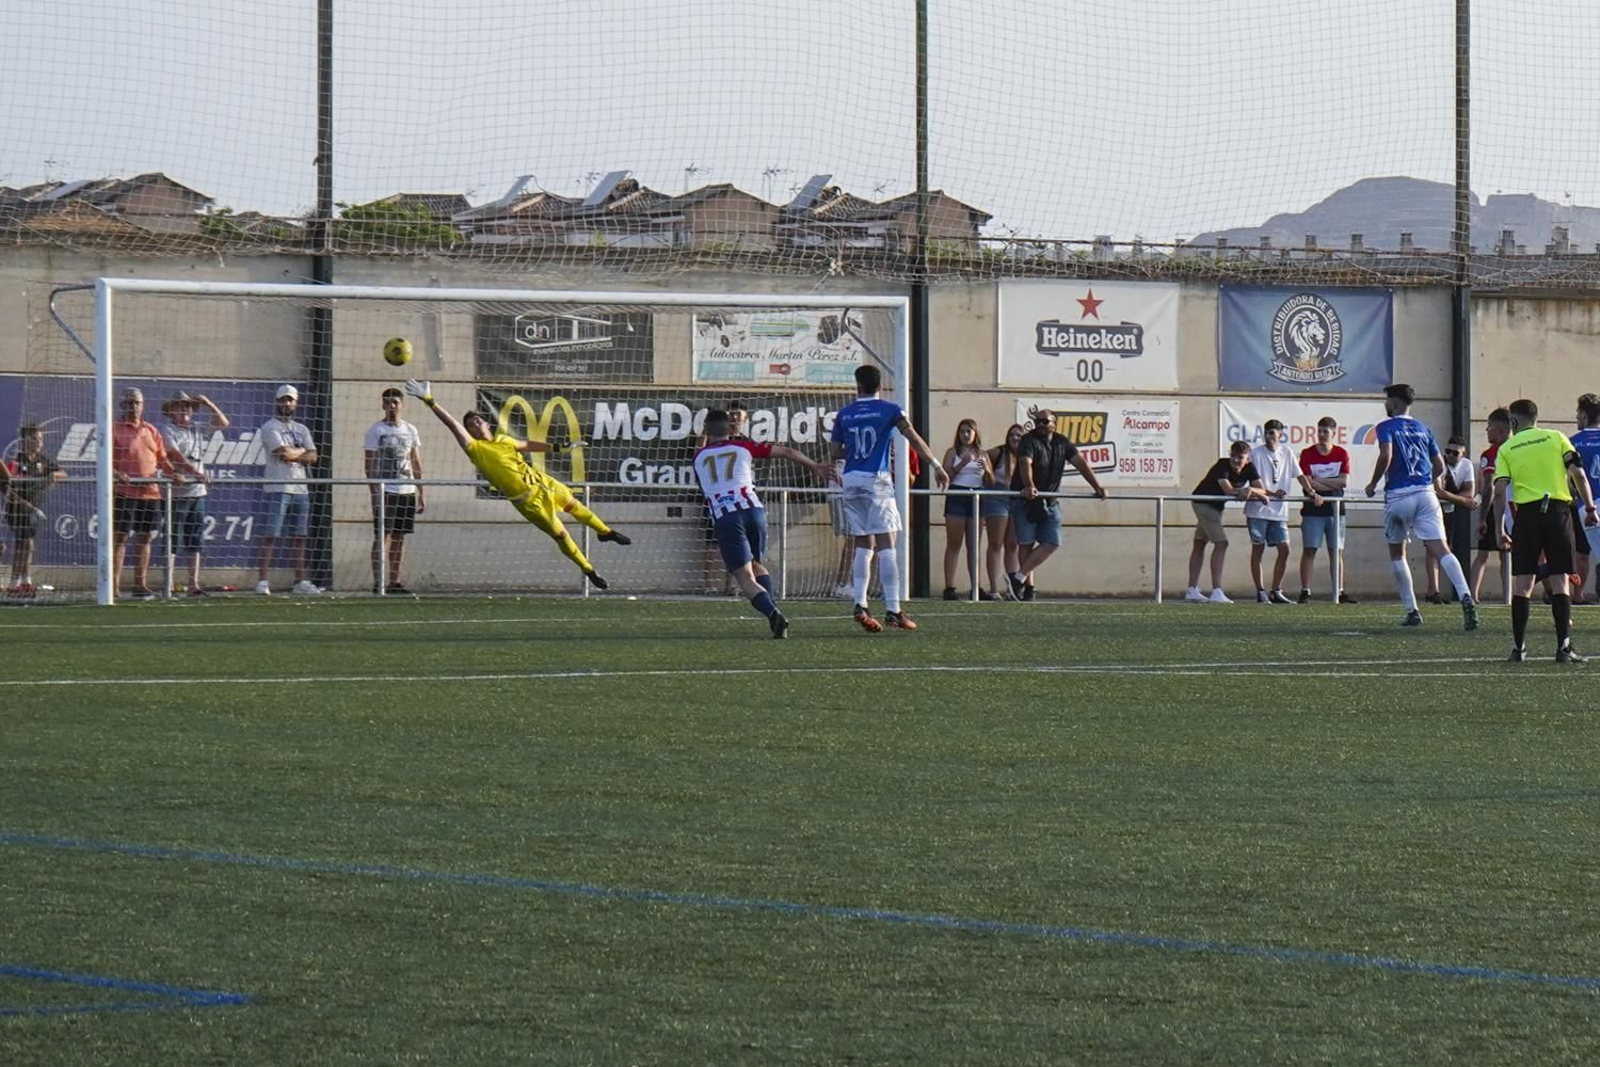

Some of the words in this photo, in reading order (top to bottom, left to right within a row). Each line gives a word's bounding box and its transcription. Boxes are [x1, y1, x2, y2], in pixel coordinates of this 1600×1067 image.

[1041, 326, 1138, 350] Heineken
[1272, 295, 1315, 355] DISTRIBUIDORA
[1315, 298, 1329, 312] DE
[1325, 309, 1341, 356] BEBIDAS
[1076, 358, 1104, 383] 0.0
[1280, 366, 1314, 380] ANTONIO
[1313, 367, 1335, 380] RUIZ
[592, 402, 839, 444] McDald's
[1055, 415, 1104, 445] UTOS
[1122, 416, 1170, 431] Alcampo
[1226, 425, 1348, 445] GLASDRE
[847, 426, 878, 460] 10
[1081, 447, 1111, 464] TOR
[619, 457, 698, 486] Gran
[702, 451, 738, 484] 17
[1119, 458, 1136, 473] 958
[1139, 458, 1155, 473] 158
[1156, 458, 1174, 473] 797
[202, 515, 217, 540] 2
[225, 515, 255, 540] 71
